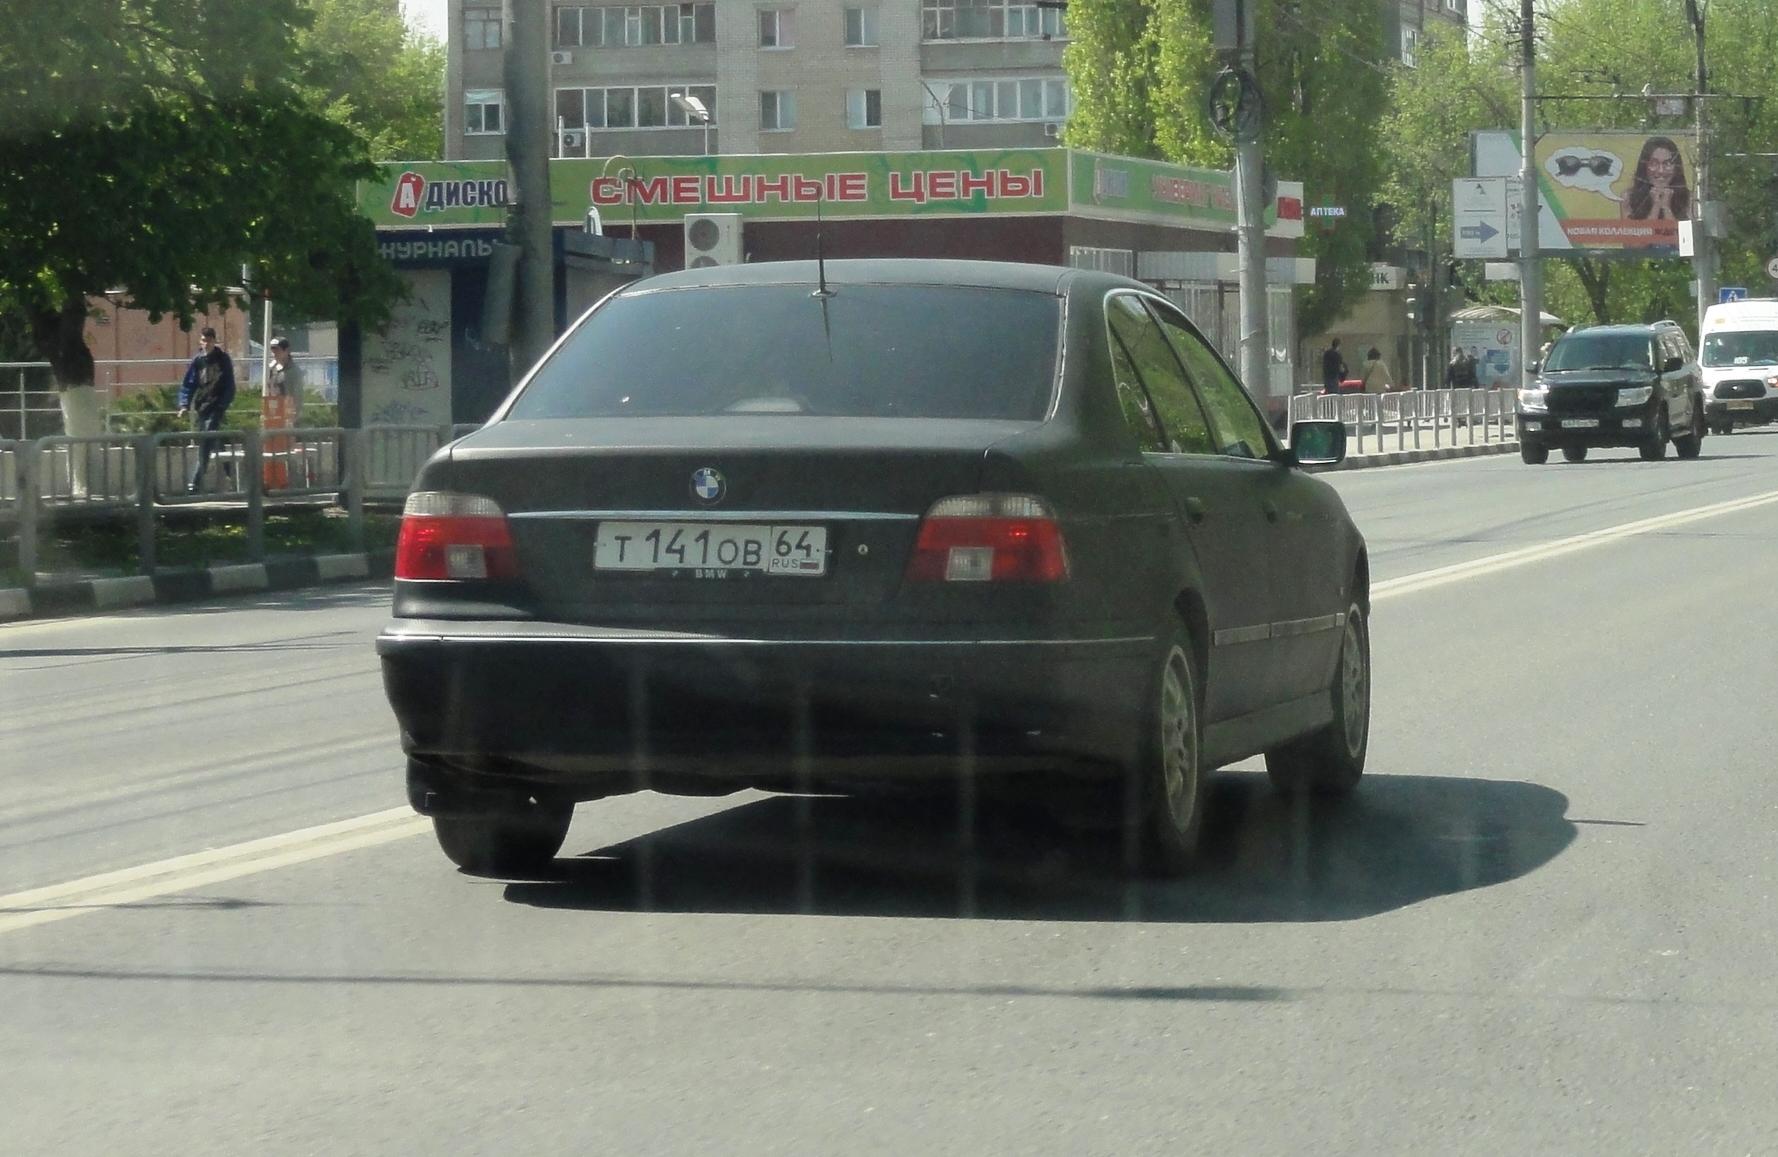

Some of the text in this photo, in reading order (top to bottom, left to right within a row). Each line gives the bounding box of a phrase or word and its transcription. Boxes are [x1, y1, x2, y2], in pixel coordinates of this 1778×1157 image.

[592, 169, 1043, 205] СМЕШНЫЕ ЦЕНЫ
[1310, 207, 1345, 216] АПТЕКА
[1598, 227, 1653, 237] КОЛЛЕКЦИЯ
[775, 530, 811, 557] 64
[771, 558, 798, 569] RUS
[695, 568, 727, 579] BMW
